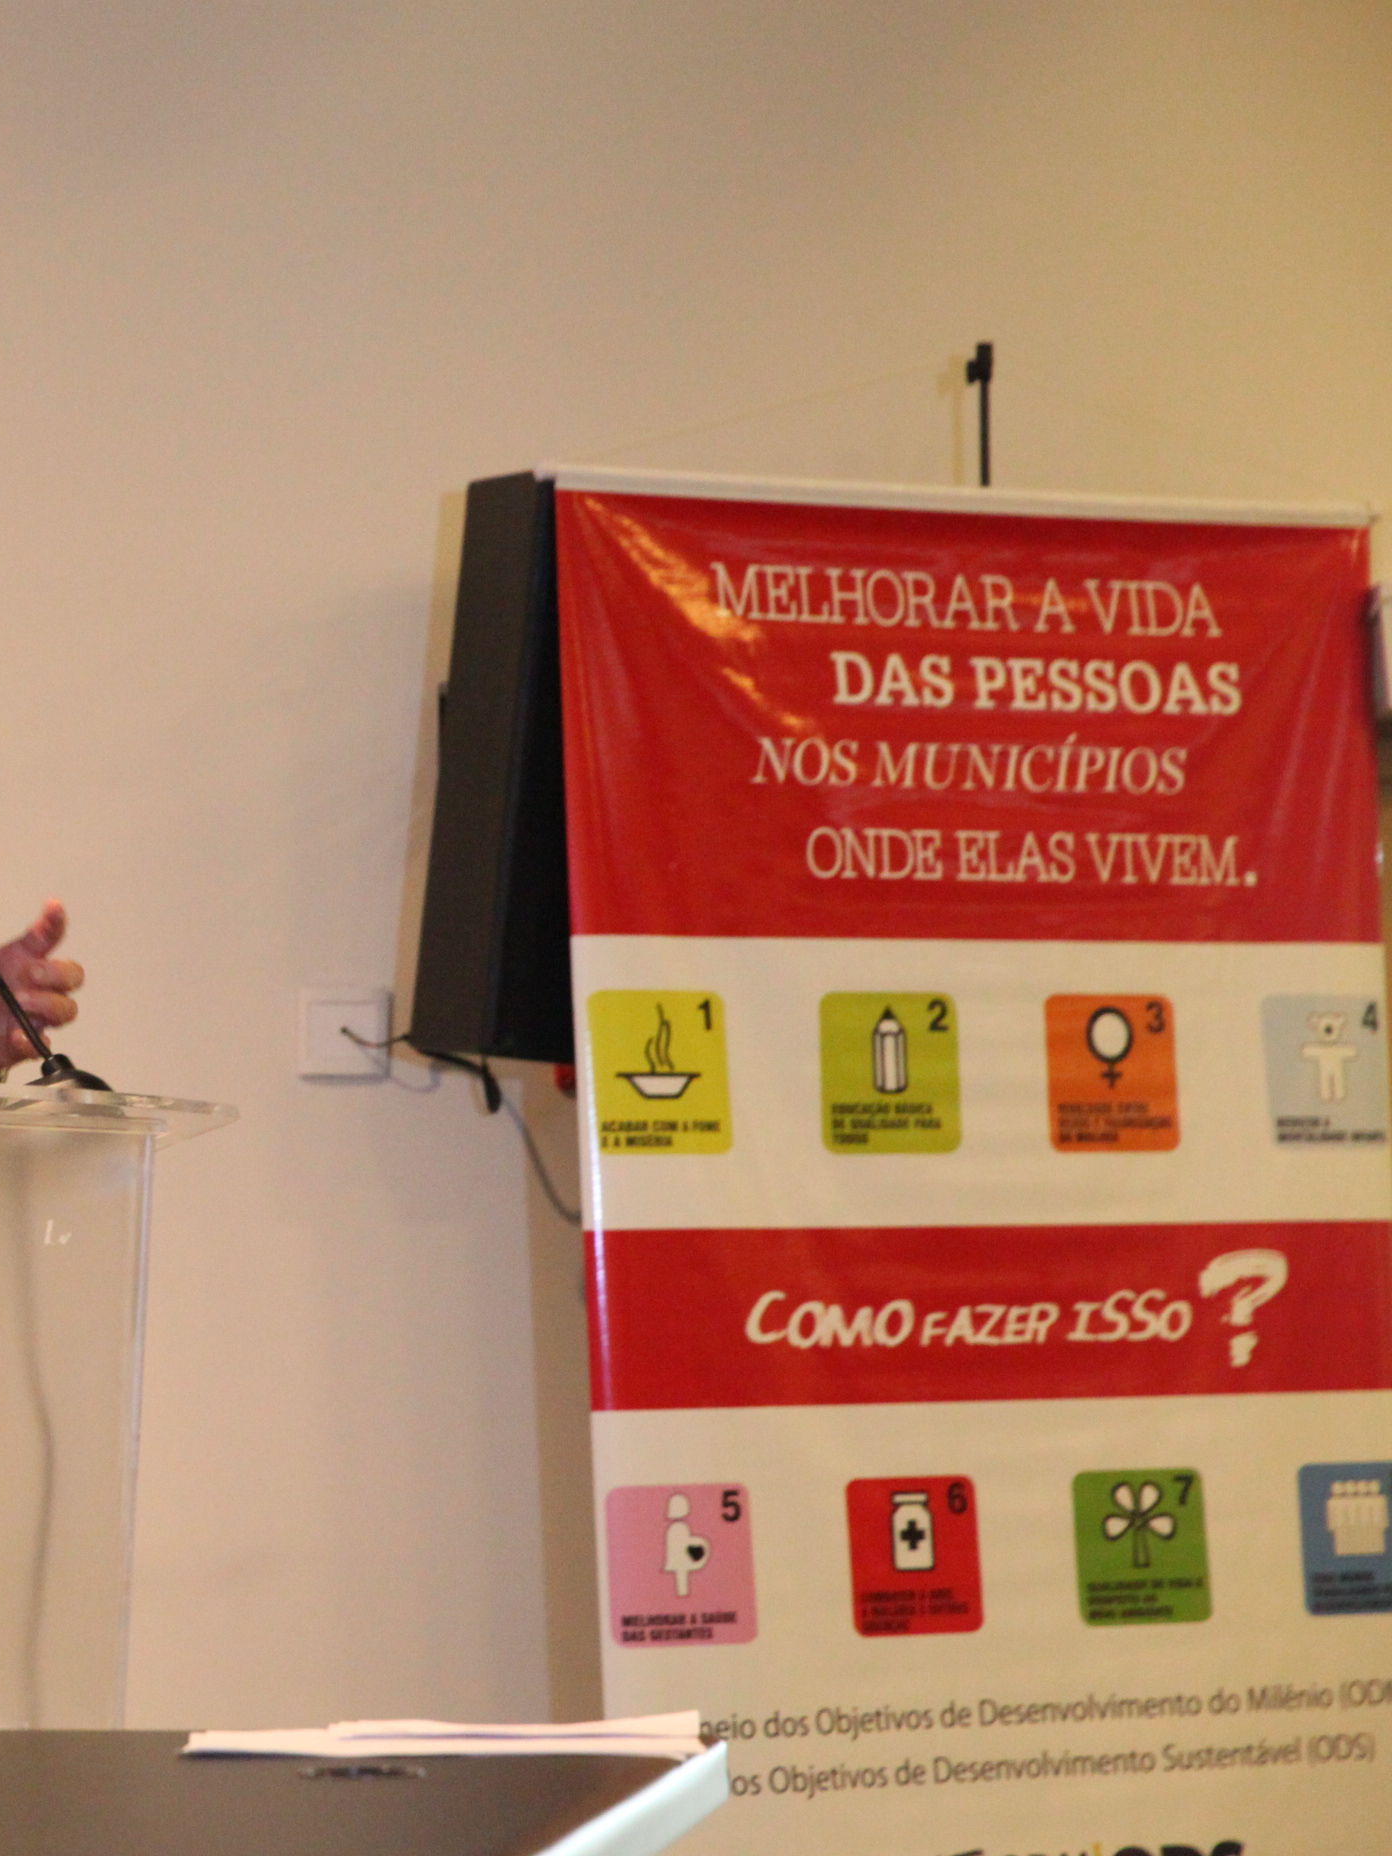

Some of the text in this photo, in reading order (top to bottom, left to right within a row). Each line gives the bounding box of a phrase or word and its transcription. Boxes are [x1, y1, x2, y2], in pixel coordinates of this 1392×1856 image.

[710, 561, 1223, 637] MELHORAR A VIDA
[830, 651, 1242, 716] DAS PESSOAS
[749, 731, 1188, 796] NOS MUNICÍPIOS
[806, 826, 1258, 888] ONDE ELAS VIVEM.
[698, 998, 712, 1031] 1
[928, 998, 949, 1032] 2
[1146, 1000, 1165, 1033] 3
[1362, 1001, 1378, 1033] 4
[745, 1290, 914, 1348] COMO
[921, 1303, 1058, 1346] FAZER
[722, 1490, 741, 1522] 5
[947, 1482, 968, 1515] 6
[1173, 1474, 1194, 1506] 7
[763, 1710, 809, 1739] dos
[815, 1705, 933, 1741] Objetivos
[940, 1702, 971, 1728] de
[979, 1693, 1202, 1727] Desenvolvimento
[1210, 1687, 1240, 1715] do
[1247, 1682, 1333, 1711] Milênio
[769, 1763, 888, 1800] Objetivos
[895, 1758, 926, 1785] de
[933, 1750, 1156, 1784] Desenvolvimento
[1162, 1734, 1302, 1773] Sustentável
[1307, 1731, 1376, 1765] (ODS)
